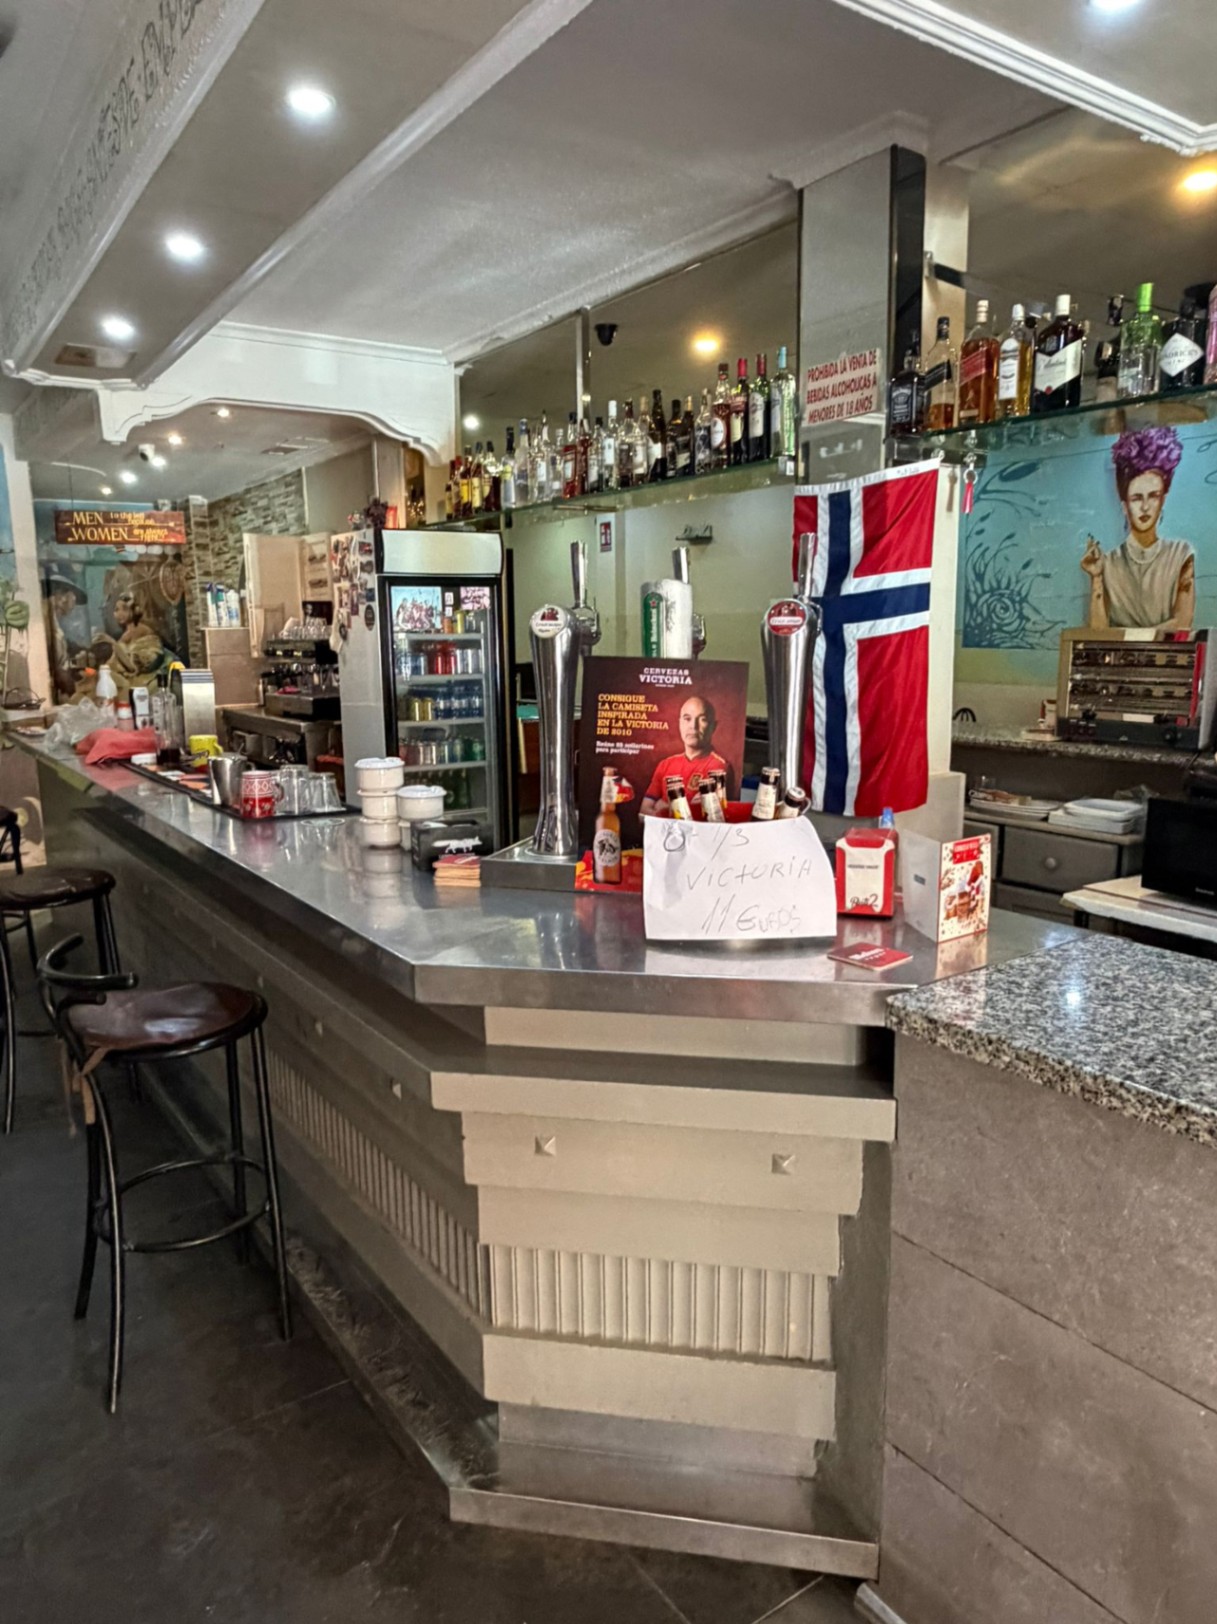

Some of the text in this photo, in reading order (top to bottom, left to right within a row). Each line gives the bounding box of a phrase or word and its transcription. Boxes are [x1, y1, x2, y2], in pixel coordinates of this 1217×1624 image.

[807, 349, 877, 383] PROHIBIDA LA VENTA DE
[806, 384, 830, 404] BEBIDAS
[871, 372, 877, 388] A
[807, 404, 836, 424] MENORES
[836, 402, 845, 418] DE
[846, 400, 854, 416] 18
[854, 392, 873, 413] AÑOS
[71, 511, 104, 525] MEN
[71, 527, 129, 541] WOMEN
[643, 667, 690, 676] CERVEZAS
[639, 674, 693, 685] VICTORIA
[598, 694, 646, 703] CONSIGUE
[597, 702, 659, 713] LA CAMISETA
[597, 711, 648, 720] INSPIRADA
[596, 719, 669, 730] EN LA VICTORIA
[596, 727, 632, 736] DE 2010
